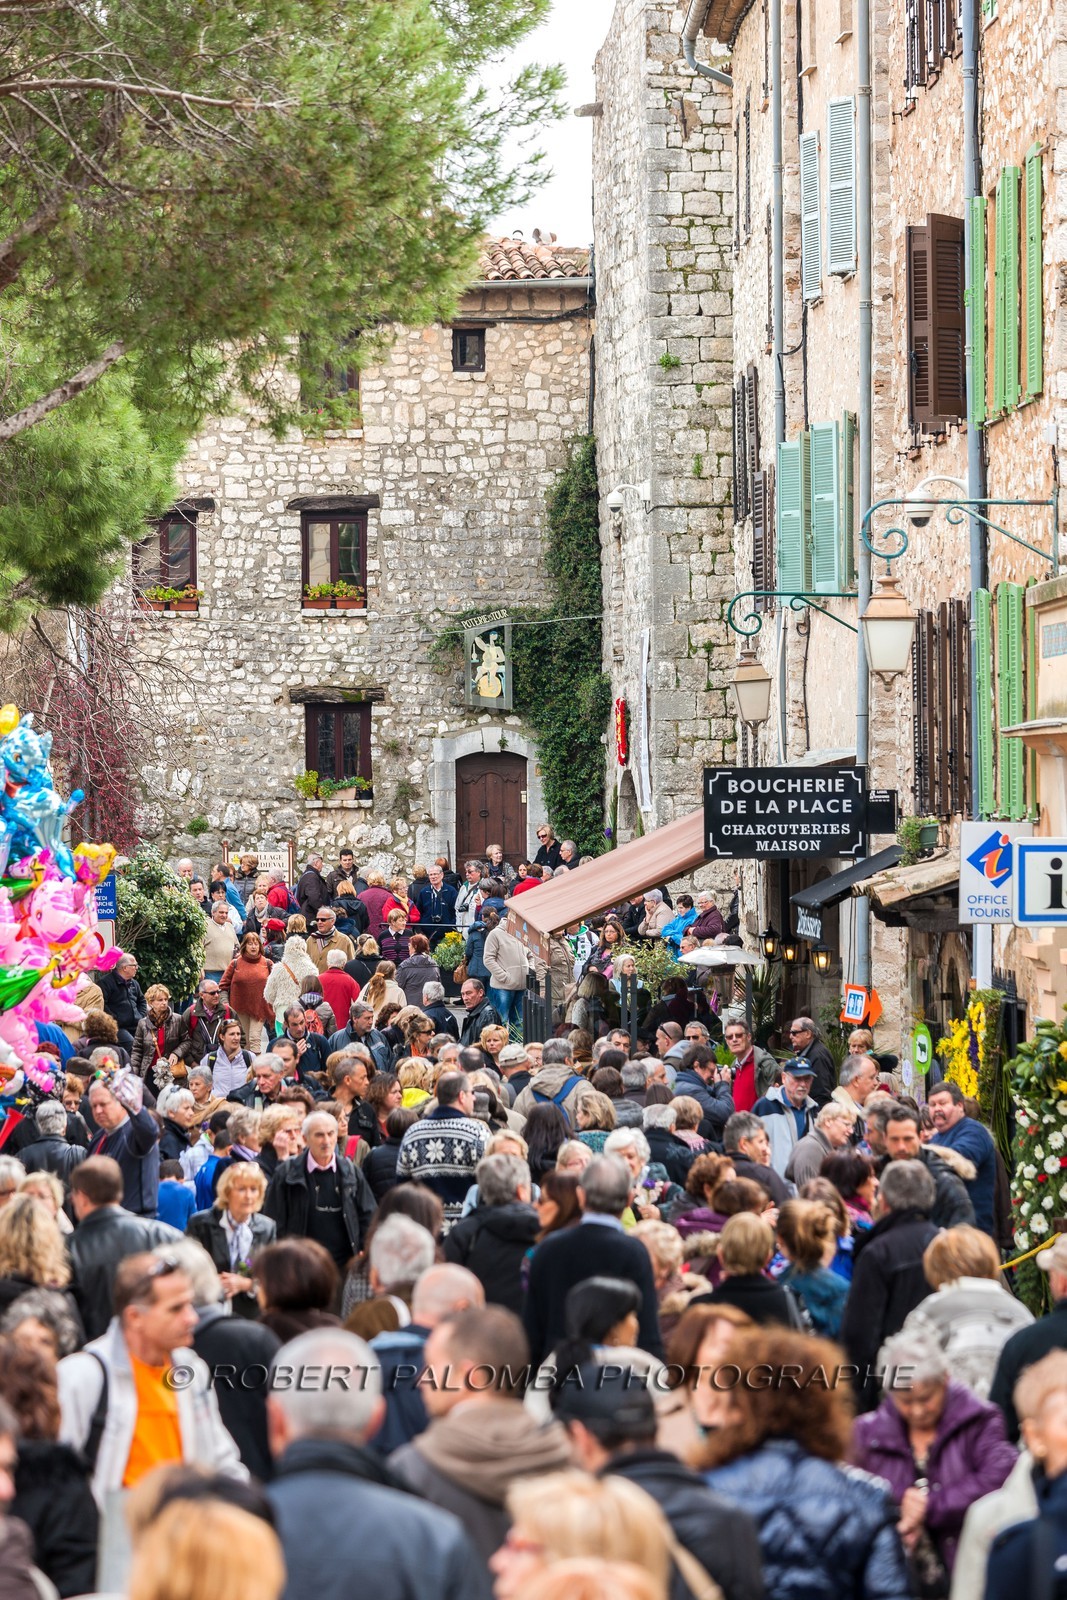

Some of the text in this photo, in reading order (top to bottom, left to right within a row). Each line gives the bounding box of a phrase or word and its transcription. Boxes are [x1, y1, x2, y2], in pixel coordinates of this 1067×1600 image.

[728, 778, 845, 794] BOUCHERIE
[720, 799, 852, 814] DE LA PLACE
[721, 823, 850, 836] CHARCUTERIES
[756, 840, 821, 851] MAISON
[967, 895, 1008, 905] OFFICE
[968, 907, 1011, 918] TOURIS
